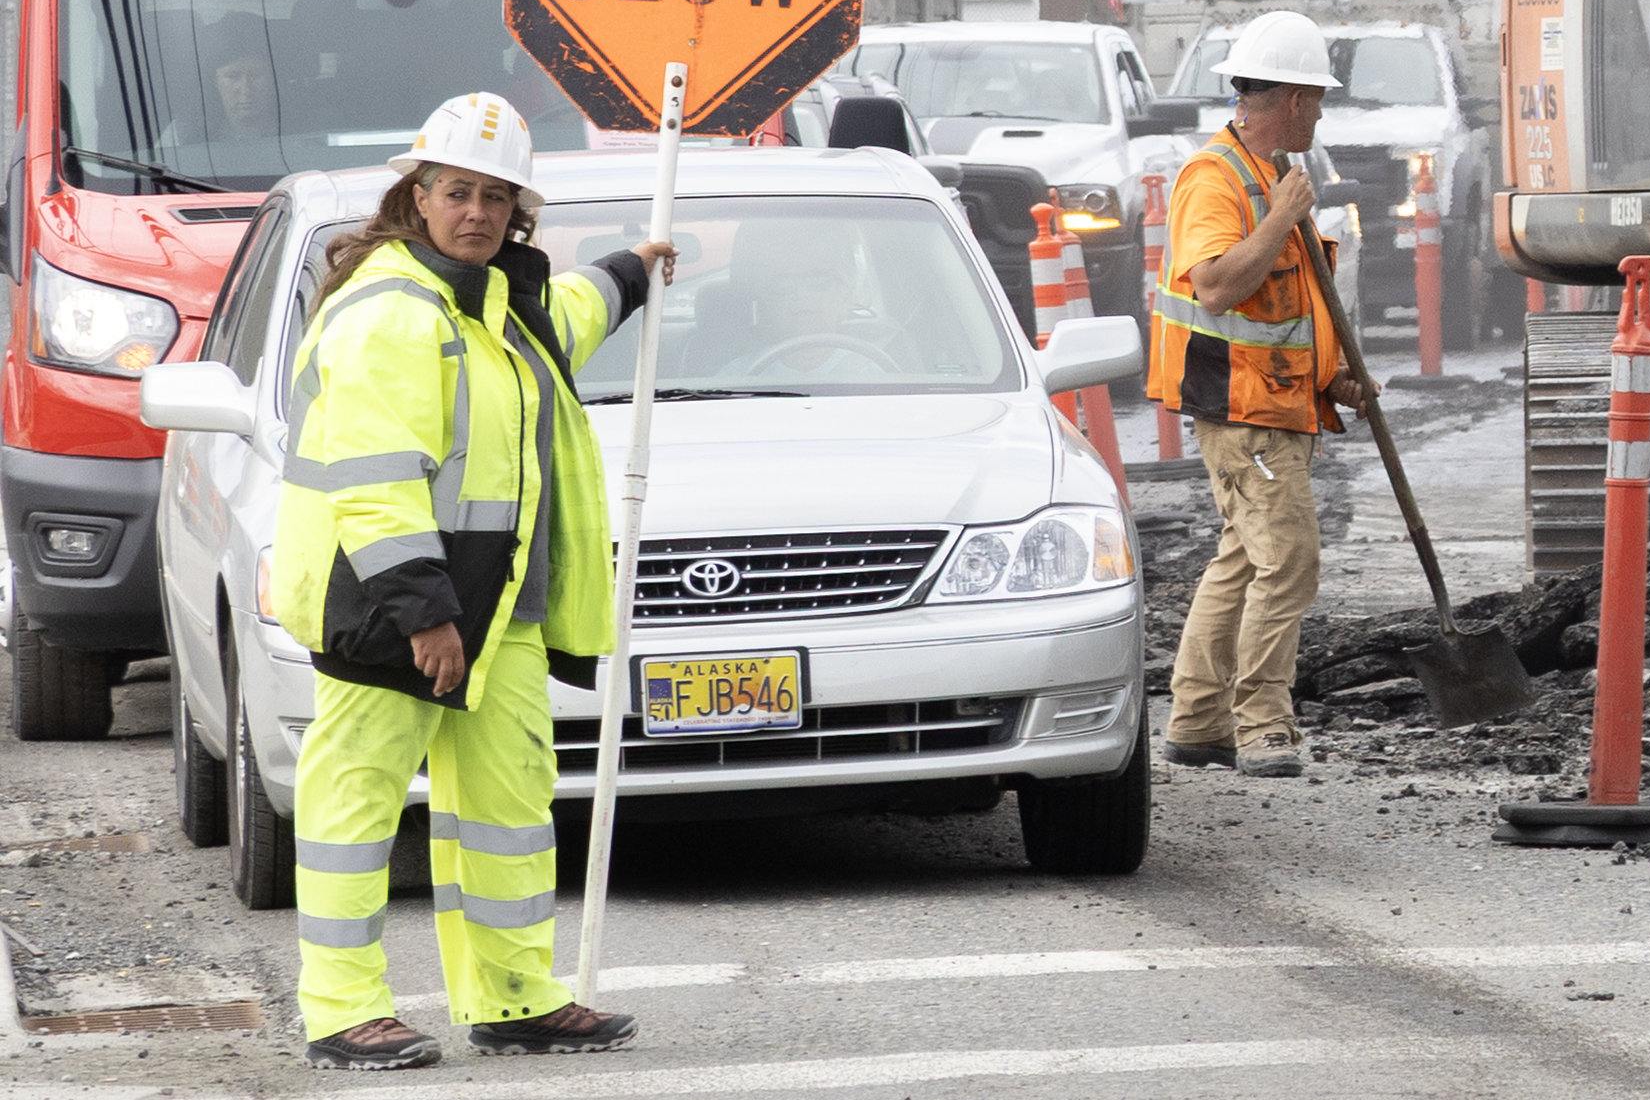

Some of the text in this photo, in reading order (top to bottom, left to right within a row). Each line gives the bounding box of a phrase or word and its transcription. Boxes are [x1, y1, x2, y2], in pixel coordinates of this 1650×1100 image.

[1519, 77, 1558, 120] ZAXIS
[1526, 125, 1553, 160] 225
[683, 662, 759, 677] ALASKA
[675, 675, 794, 718] FJB546
